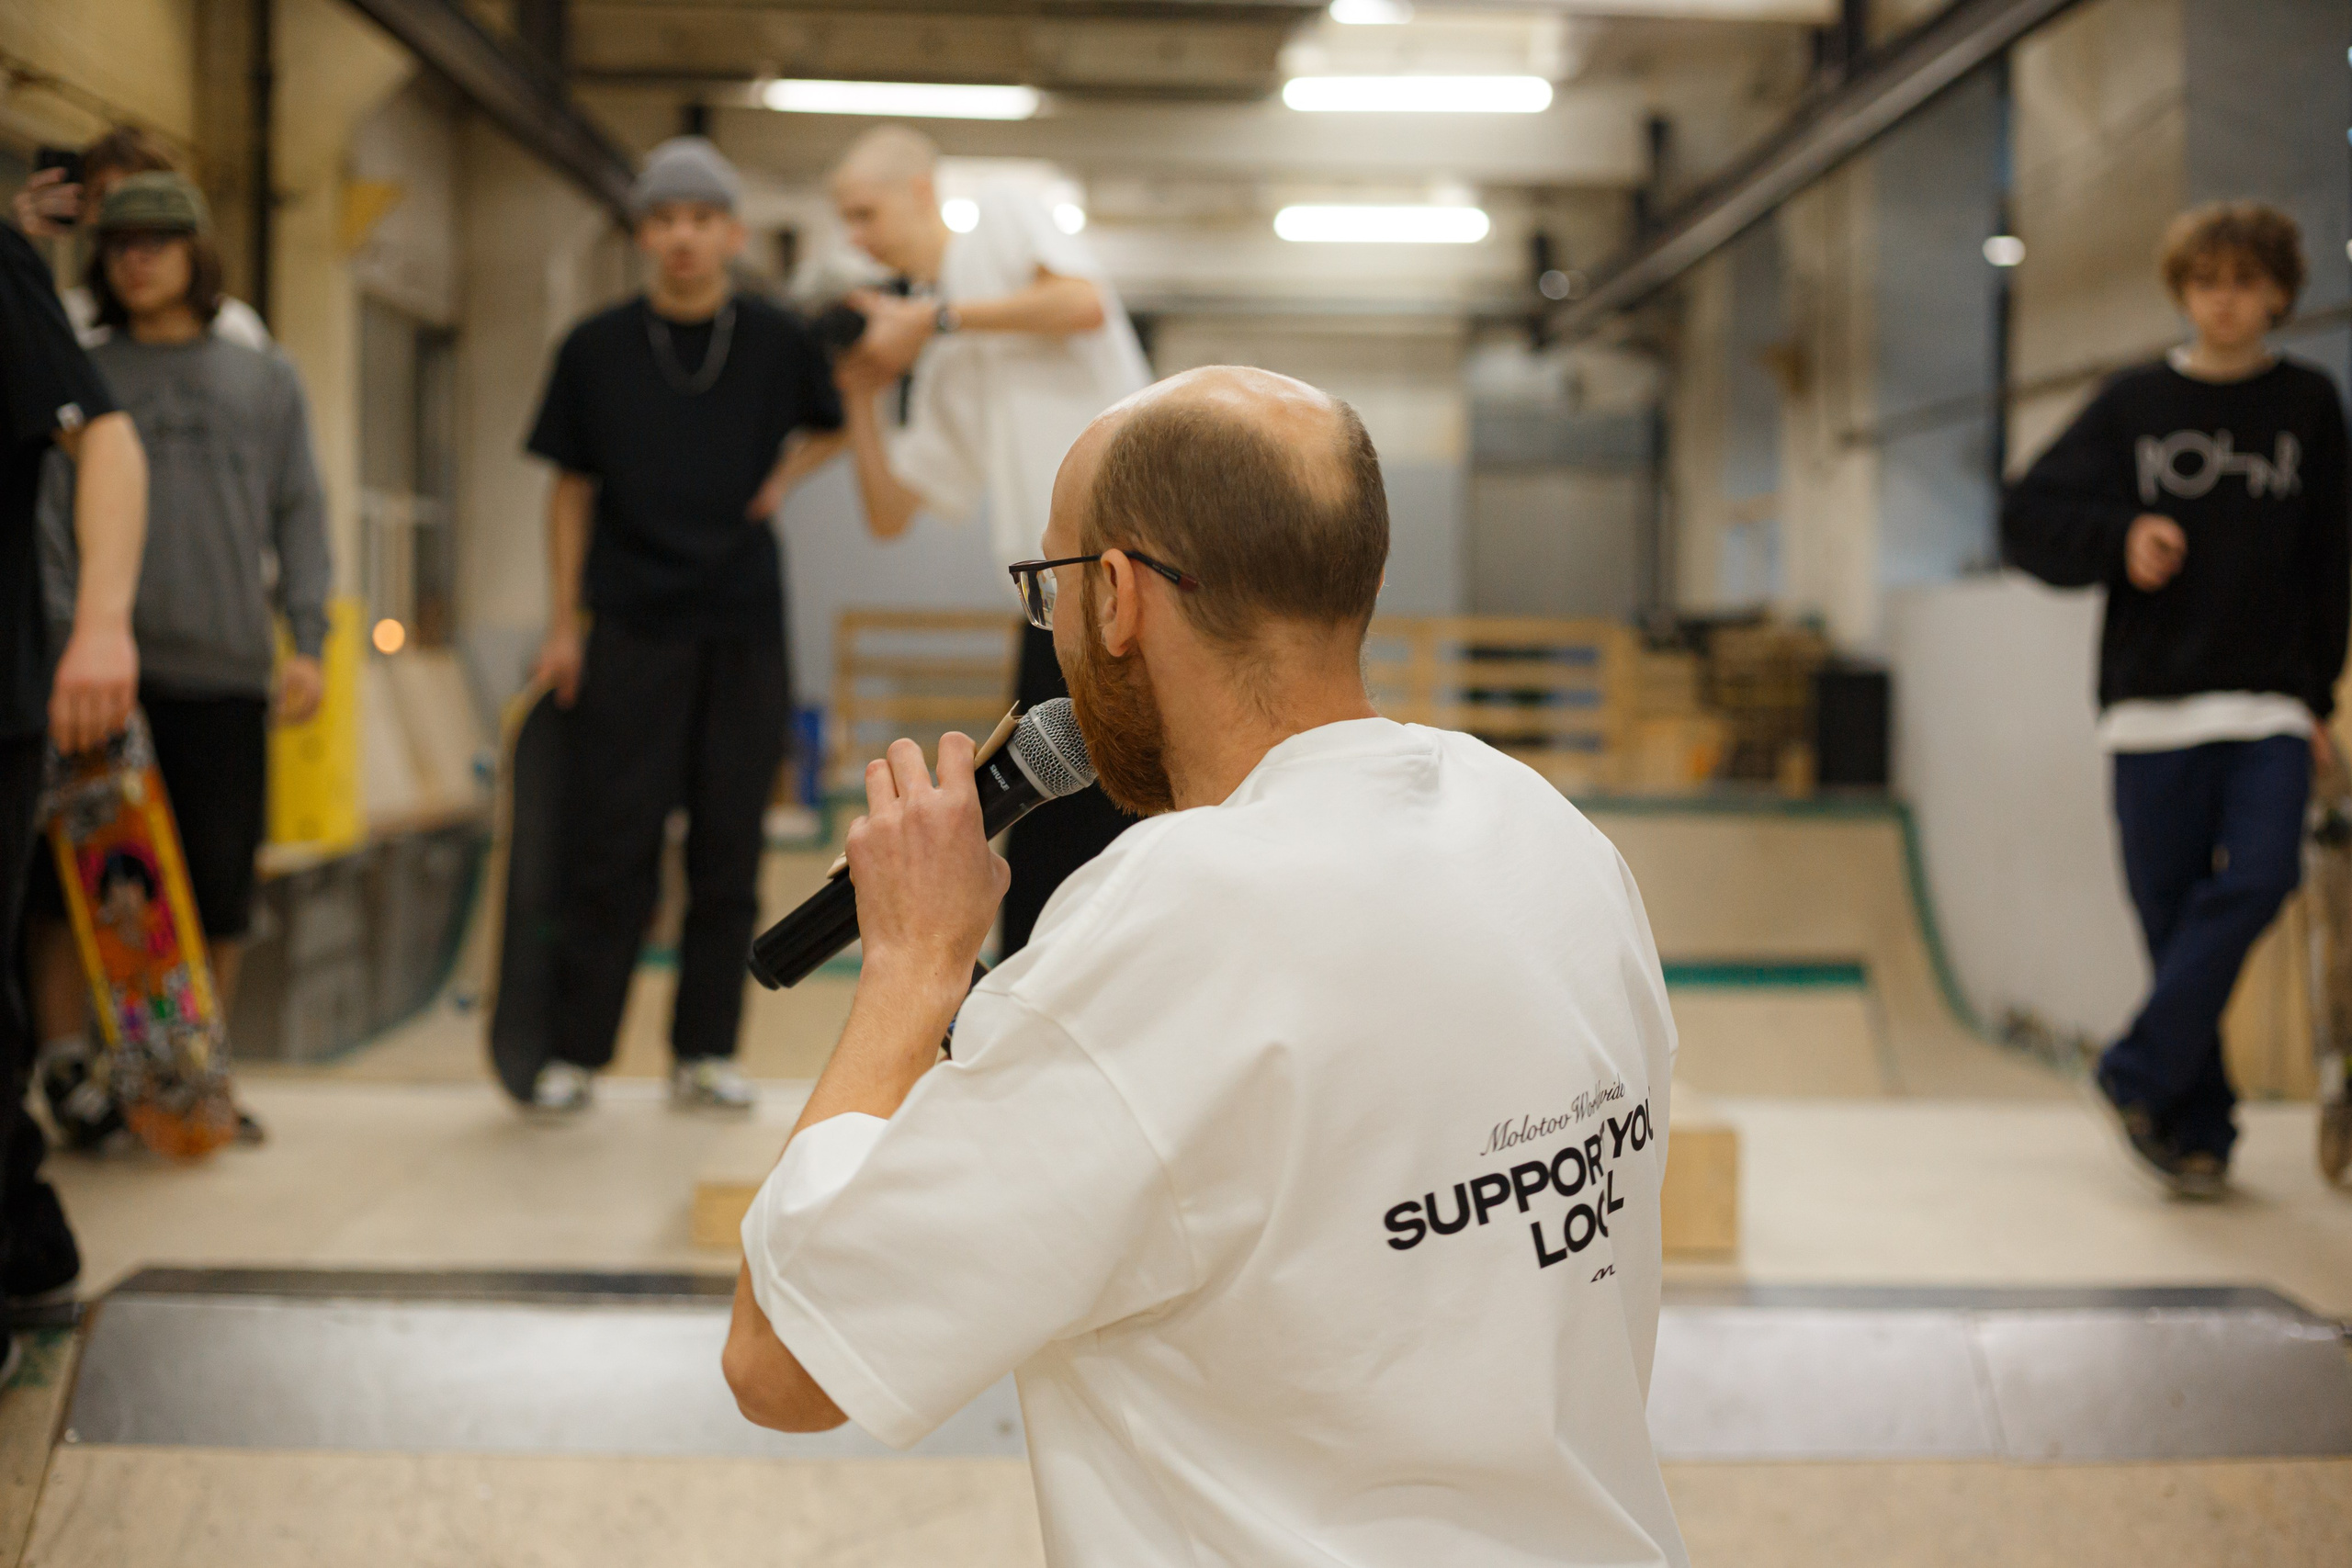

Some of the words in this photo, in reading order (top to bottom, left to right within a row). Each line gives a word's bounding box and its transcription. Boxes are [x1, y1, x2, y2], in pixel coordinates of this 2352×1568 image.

[989, 764, 1010, 791] SHURE
[1480, 1114, 1572, 1156] Molotov
[1385, 1121, 1605, 1250] SUPPOR
[1531, 1169, 1624, 1269] LOCL
